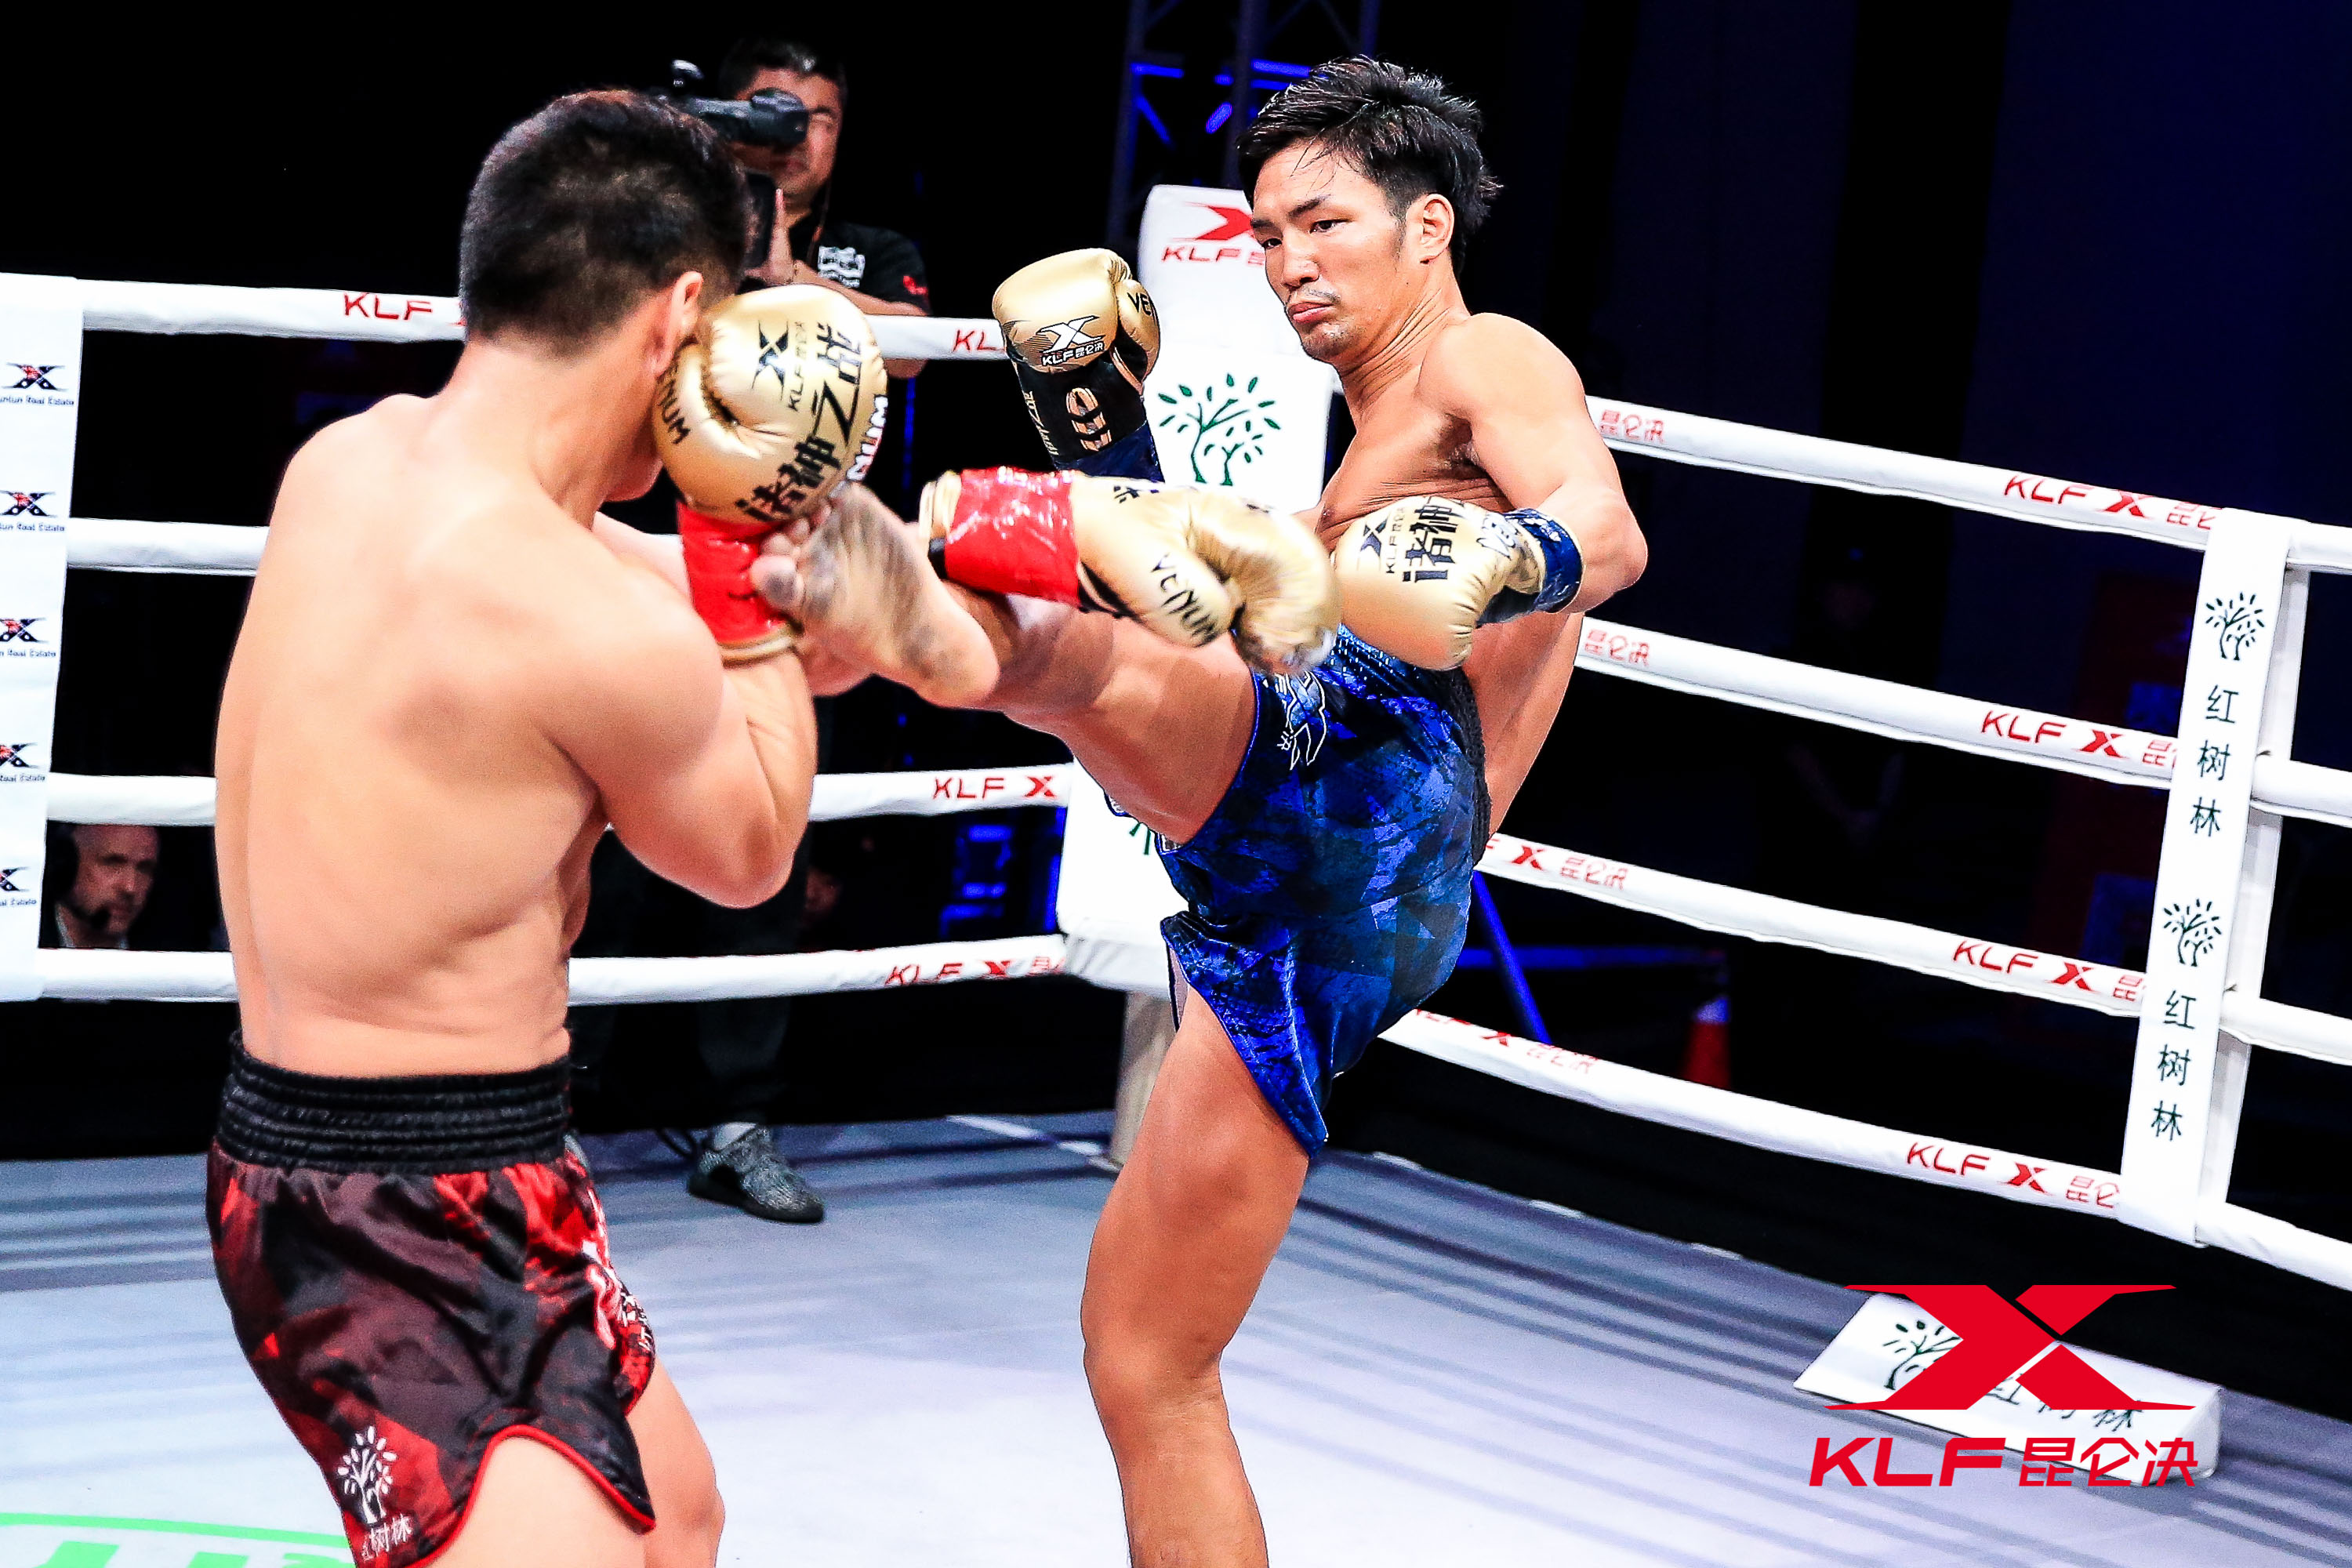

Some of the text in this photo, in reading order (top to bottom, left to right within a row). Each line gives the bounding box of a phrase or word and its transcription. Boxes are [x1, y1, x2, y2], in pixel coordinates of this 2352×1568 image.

[343, 292, 433, 321] KLF
[953, 329, 1000, 352] KL
[1042, 350, 1074, 367] KLF
[2004, 474, 2096, 504] KLF
[2167, 502, 2222, 530] 昆仑
[1402, 497, 1466, 583] 诸神
[1980, 710, 2067, 744] KLF
[2190, 684, 2240, 837] 红树林
[932, 776, 1005, 800] KLF
[1952, 940, 2038, 975] KLF
[2151, 989, 2198, 1142] 红树林
[1907, 1142, 1992, 1176] KLF
[2065, 1175, 2120, 1209] 昆仑
